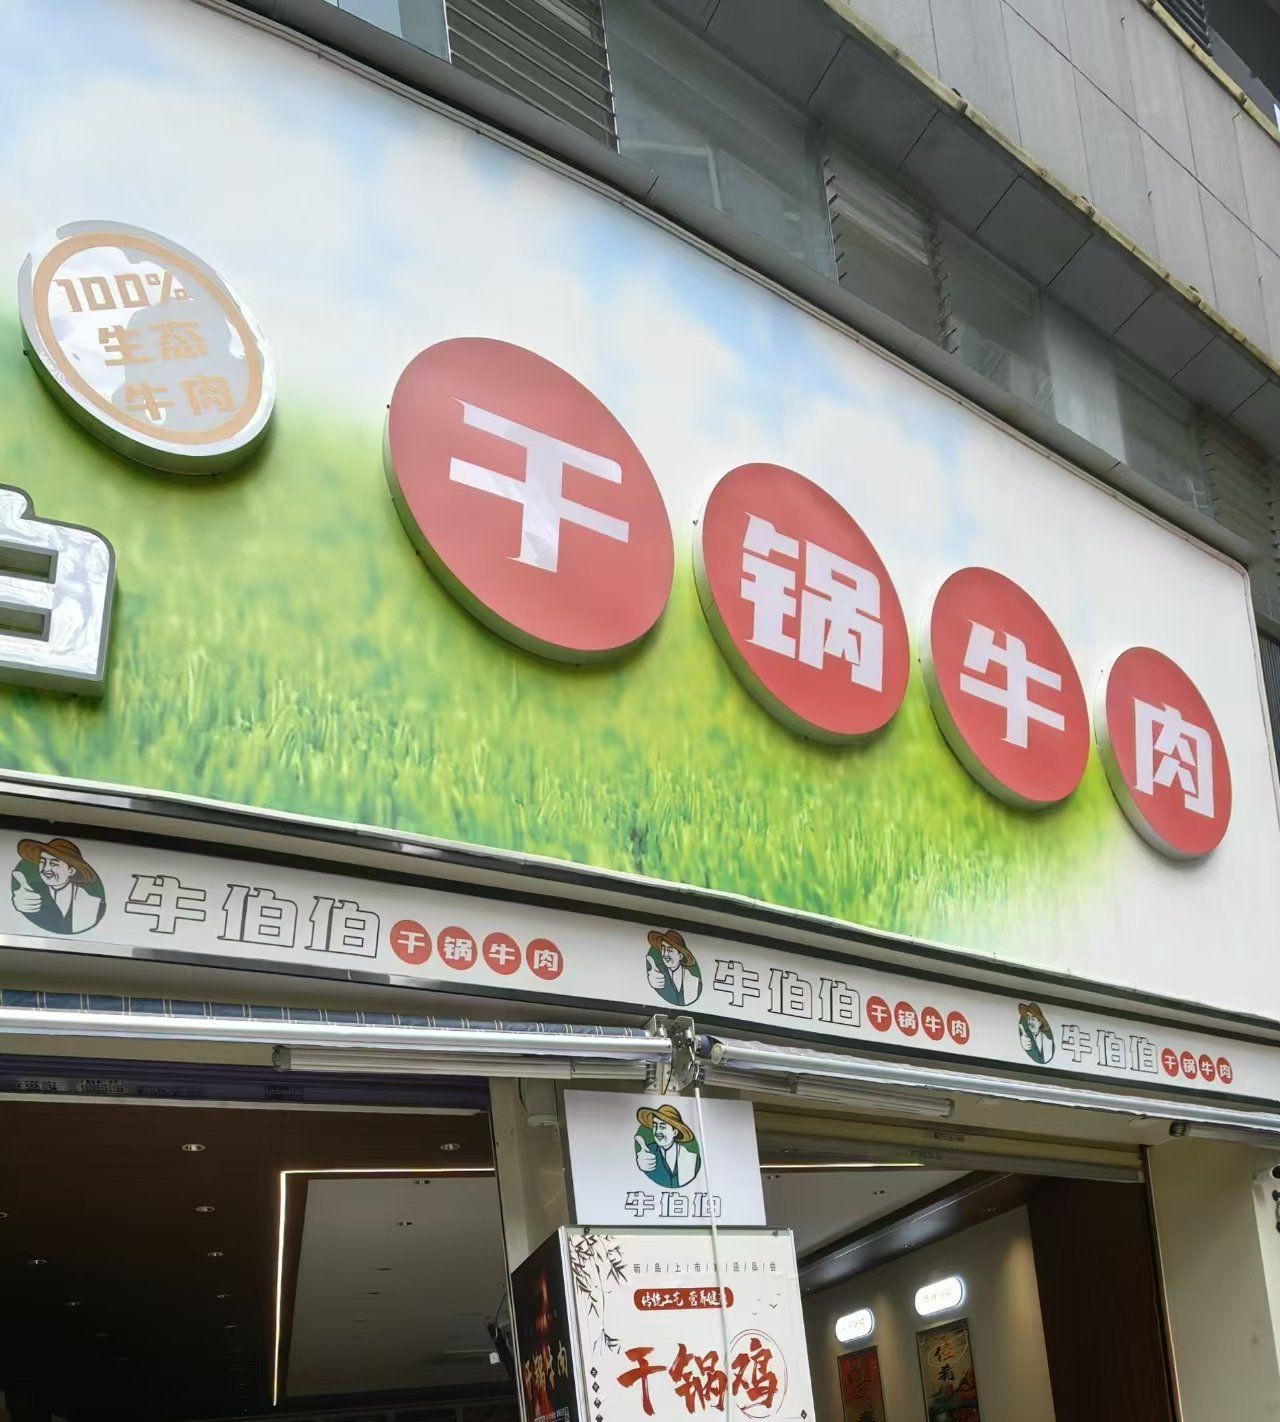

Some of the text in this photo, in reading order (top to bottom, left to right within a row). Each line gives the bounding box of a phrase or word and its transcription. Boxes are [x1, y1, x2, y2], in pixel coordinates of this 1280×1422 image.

[56, 270, 192, 314] 100%
[97, 320, 210, 368] 生态
[123, 373, 236, 422] 牛肉
[448, 396, 1216, 820] 干锅牛肉
[123, 873, 560, 973] 牛伯伯 干锅牛肉
[712, 959, 971, 1041] 牛伯伯 干锅牛肉
[1061, 1023, 1233, 1082] 牛伯伯 干锅牛肉
[624, 1190, 722, 1218] 牛伯伯
[616, 1337, 779, 1417] 干锅鸡
